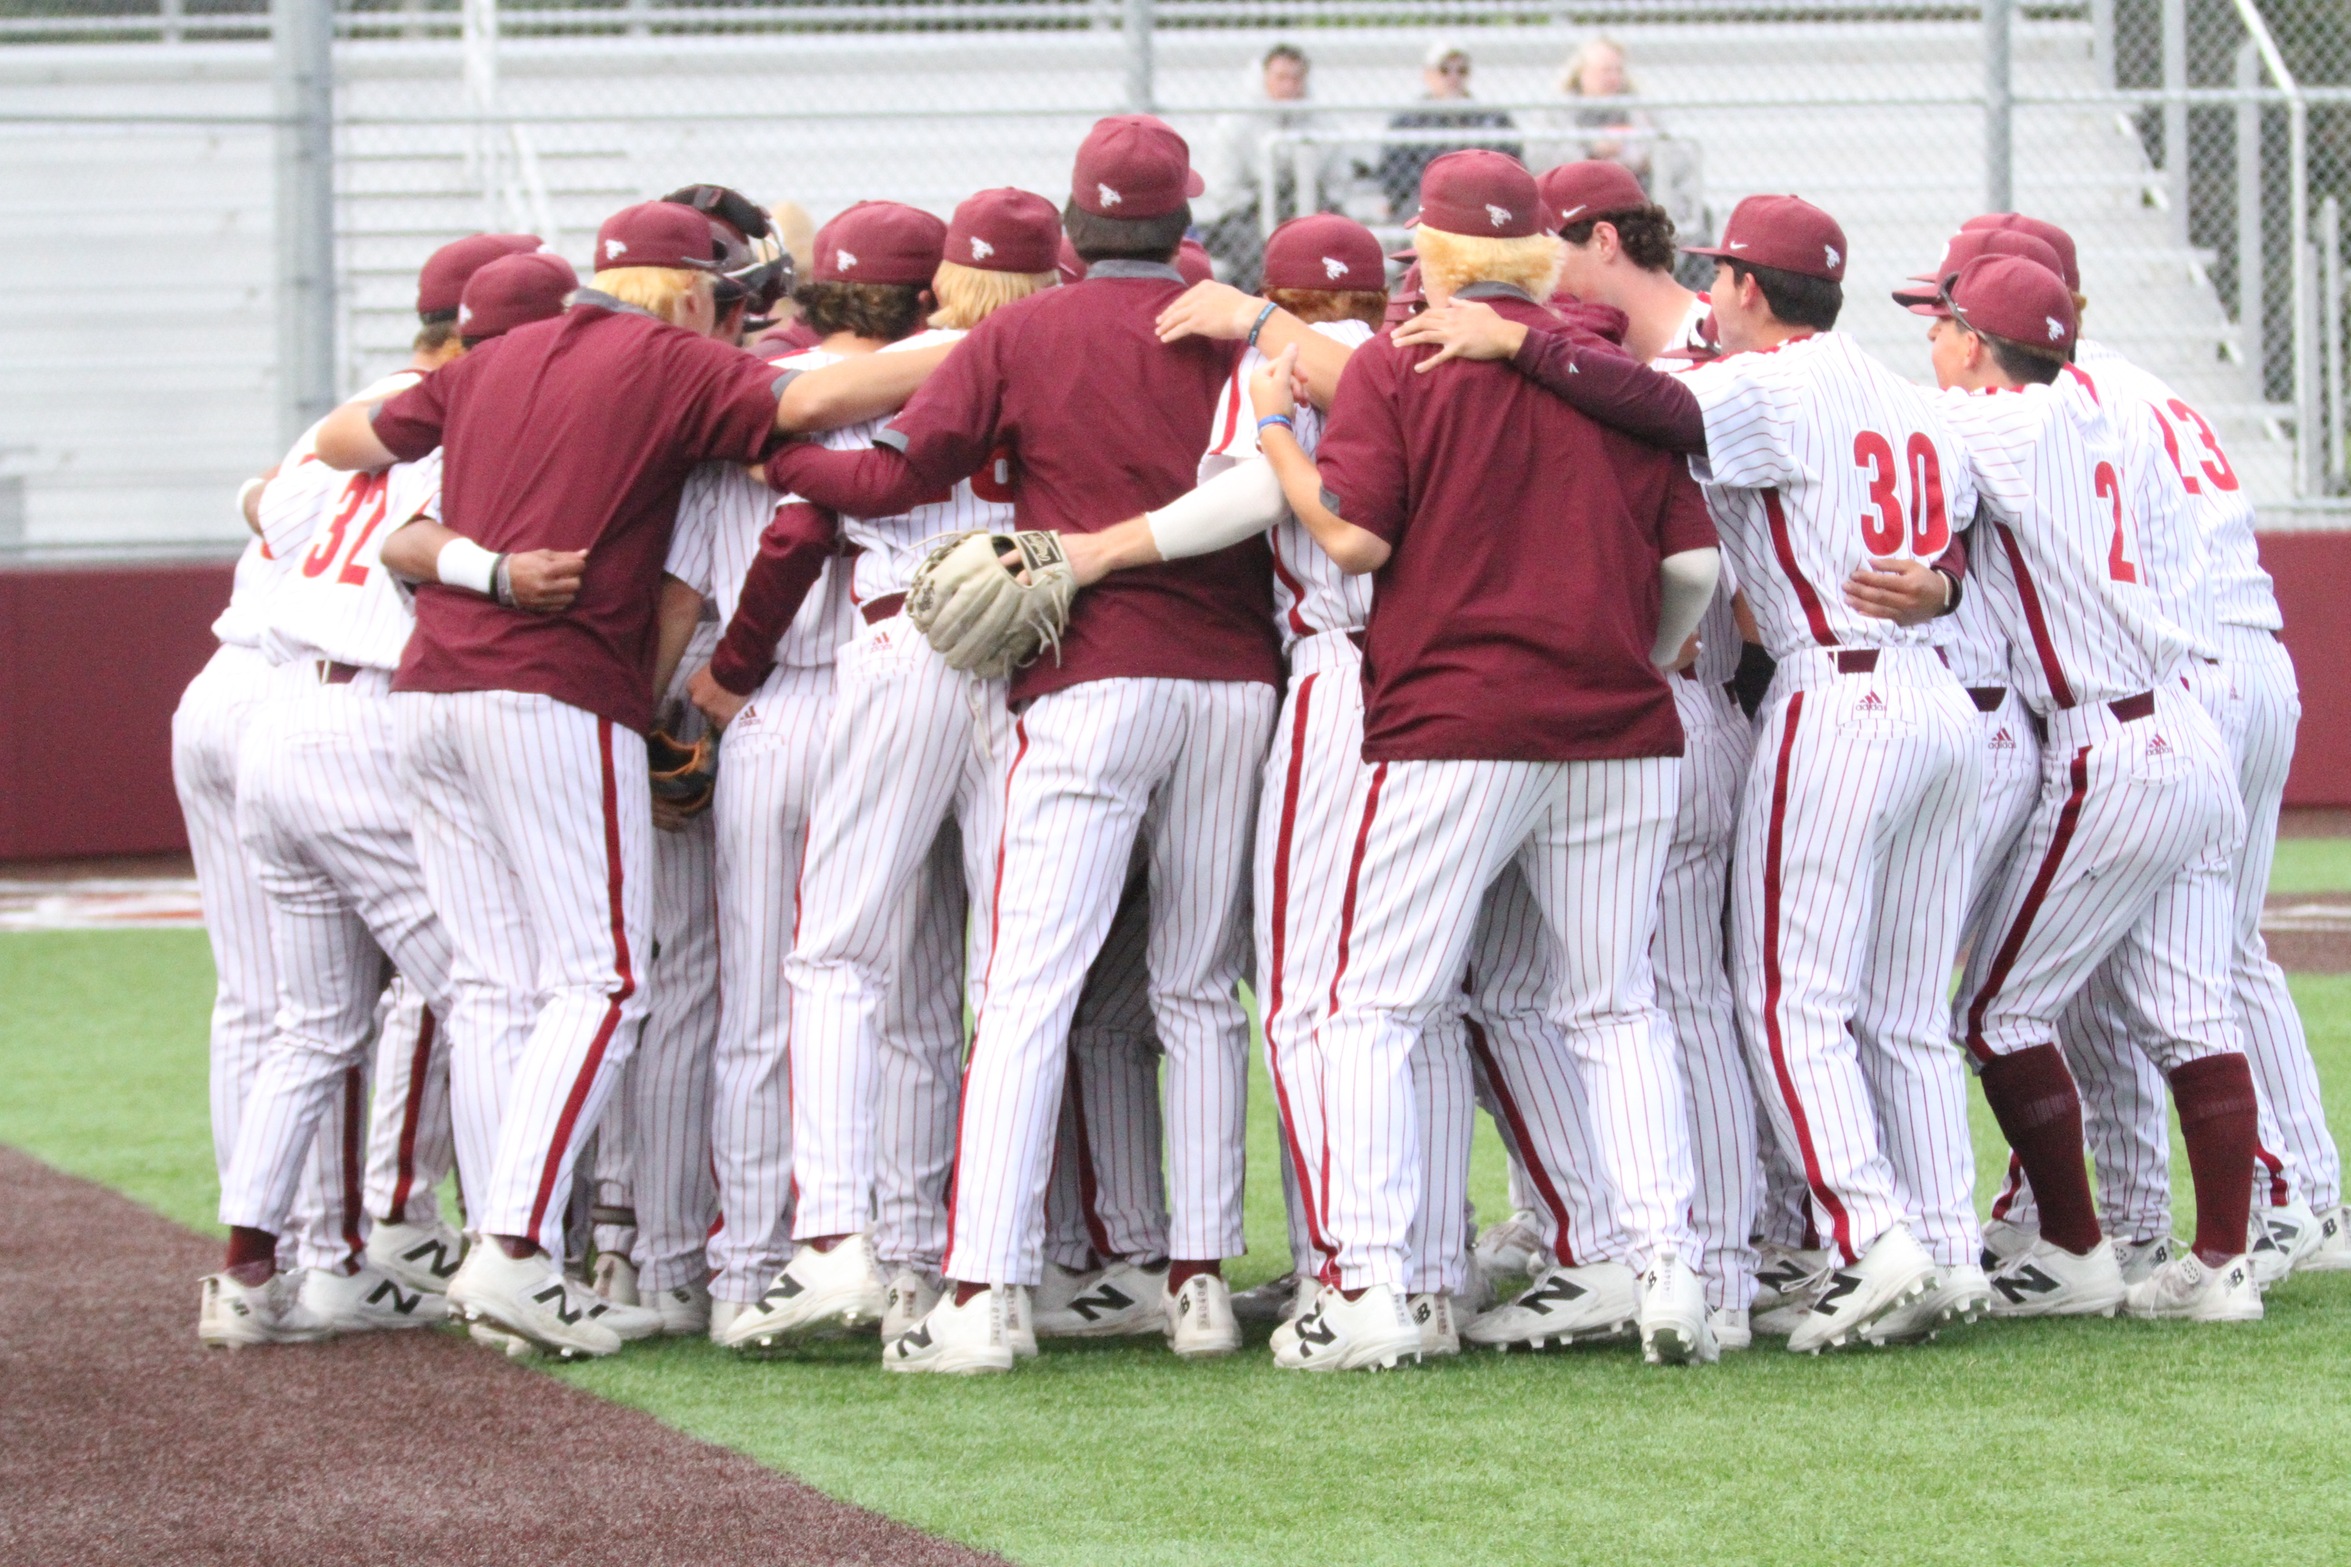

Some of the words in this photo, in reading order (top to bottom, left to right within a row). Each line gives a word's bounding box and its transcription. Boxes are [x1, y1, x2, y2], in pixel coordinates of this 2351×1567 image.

[2143, 398, 2239, 495] 23
[1854, 430, 1950, 557] 30
[303, 470, 389, 586] 32
[1988, 738, 2017, 750] adidas
[366, 1279, 422, 1315] N
[532, 1284, 582, 1325] N
[755, 1272, 806, 1315] N
[1067, 1283, 1135, 1321] N
[1516, 1275, 1588, 1316] N
[1991, 1264, 2061, 1304] N
